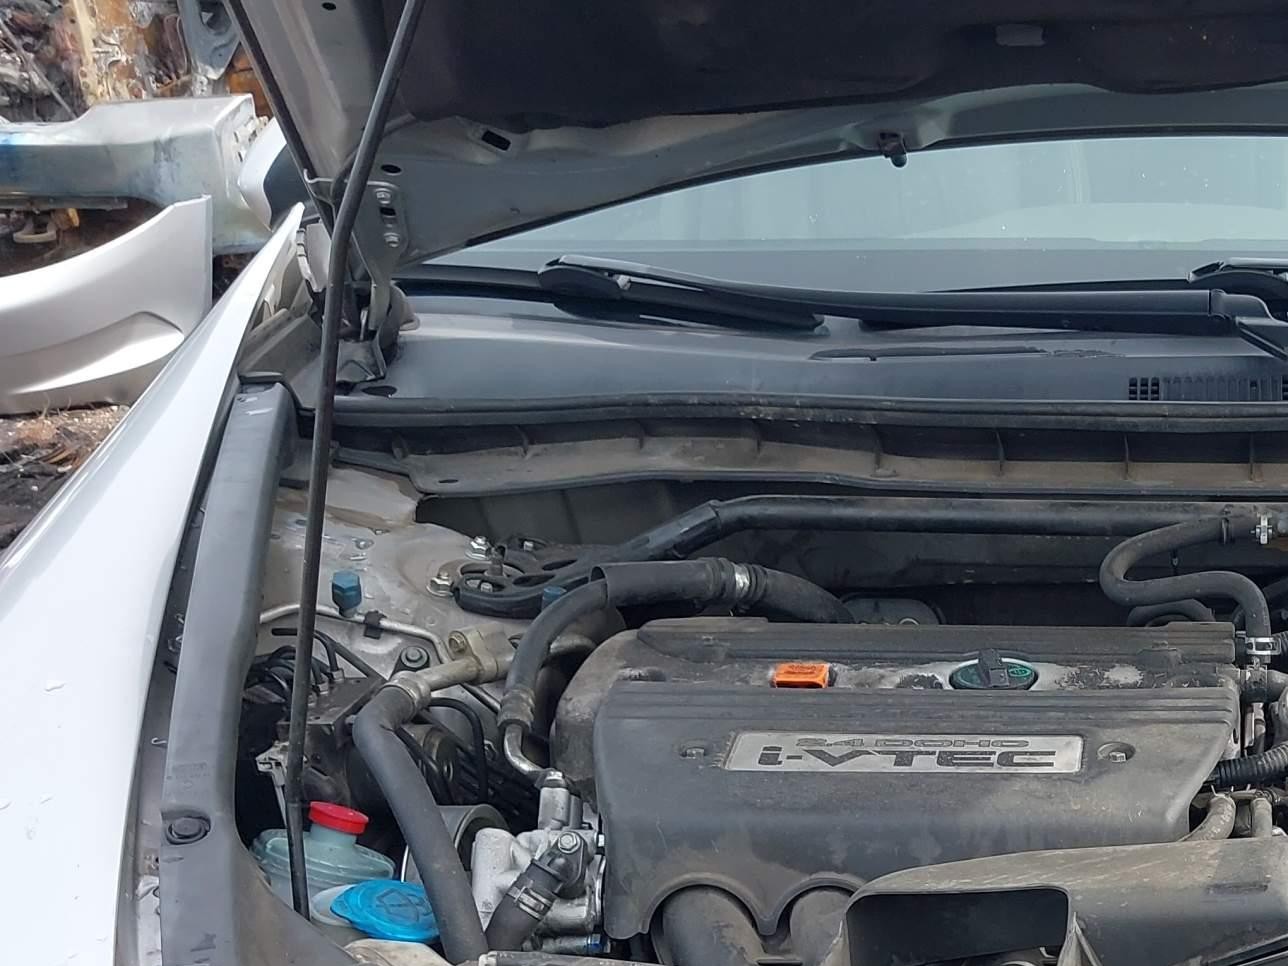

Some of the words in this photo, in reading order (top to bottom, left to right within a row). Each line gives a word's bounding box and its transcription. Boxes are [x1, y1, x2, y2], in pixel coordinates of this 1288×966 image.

[796, 738, 864, 747] 2.4
[874, 739, 1030, 748] DOHC
[758, 746, 1057, 767] i-VTEC
